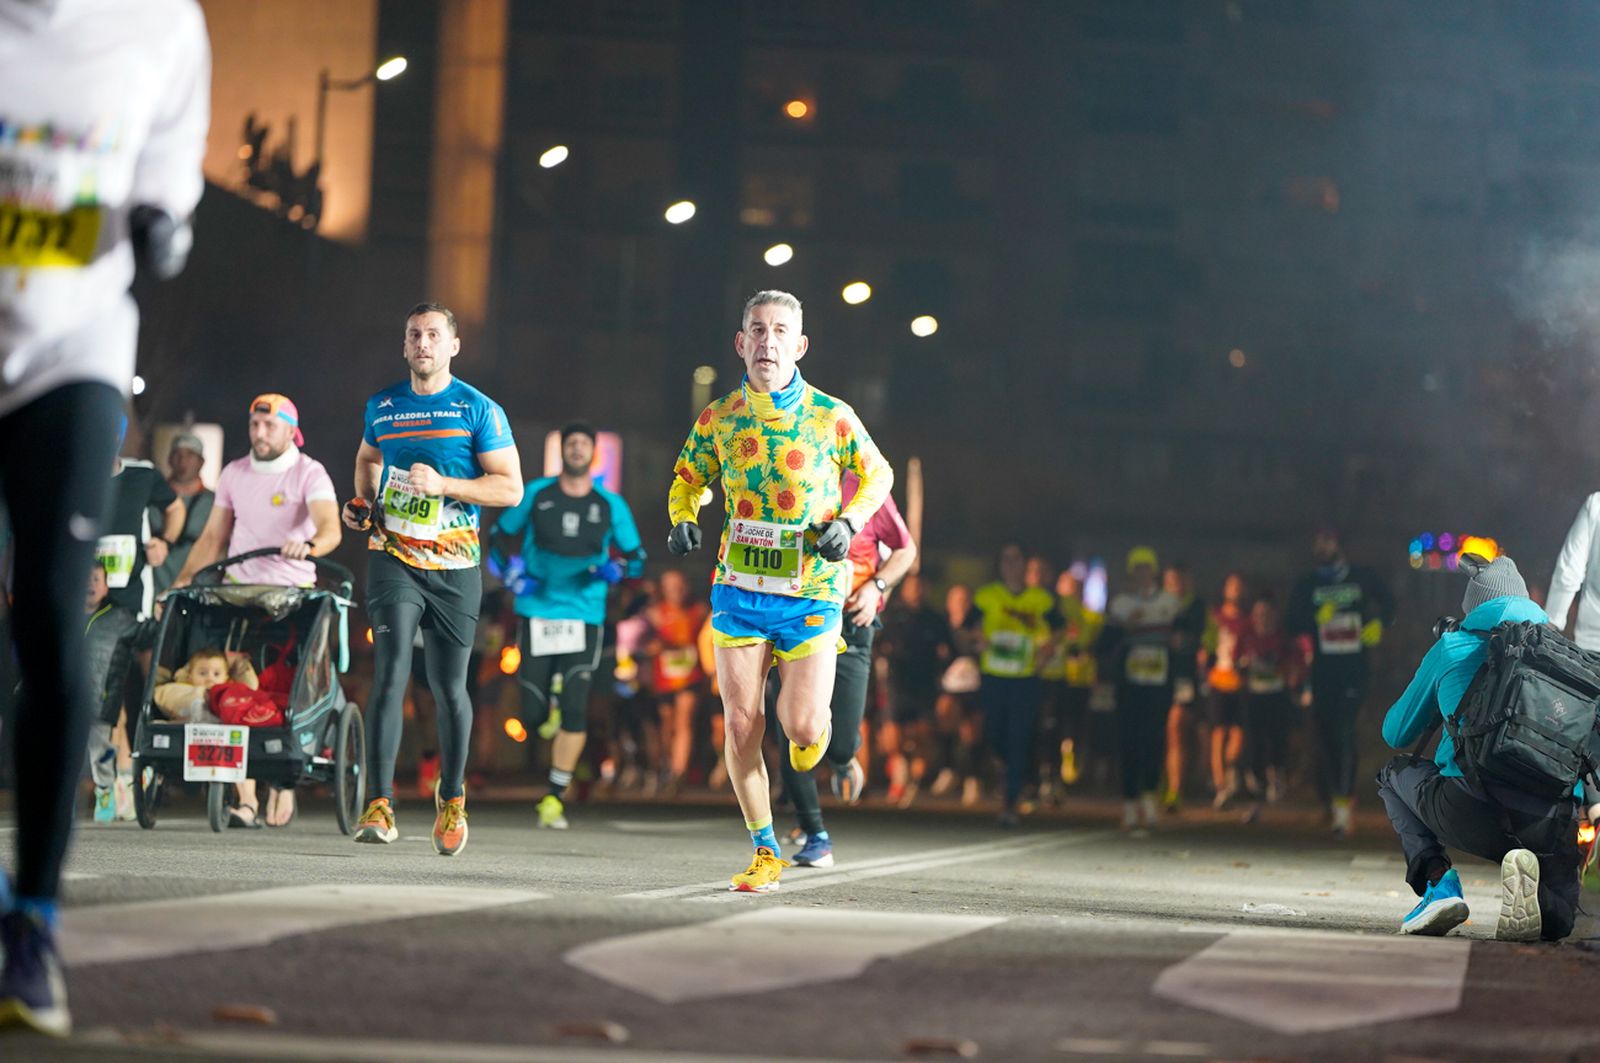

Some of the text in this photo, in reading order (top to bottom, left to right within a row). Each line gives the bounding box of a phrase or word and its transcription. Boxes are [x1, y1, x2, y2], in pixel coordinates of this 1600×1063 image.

[394, 412, 431, 420] CAZORLA
[765, 530, 774, 538] DE
[736, 535, 748, 544] SAN
[749, 536, 774, 547] ANTÓN
[744, 546, 782, 569] 1110
